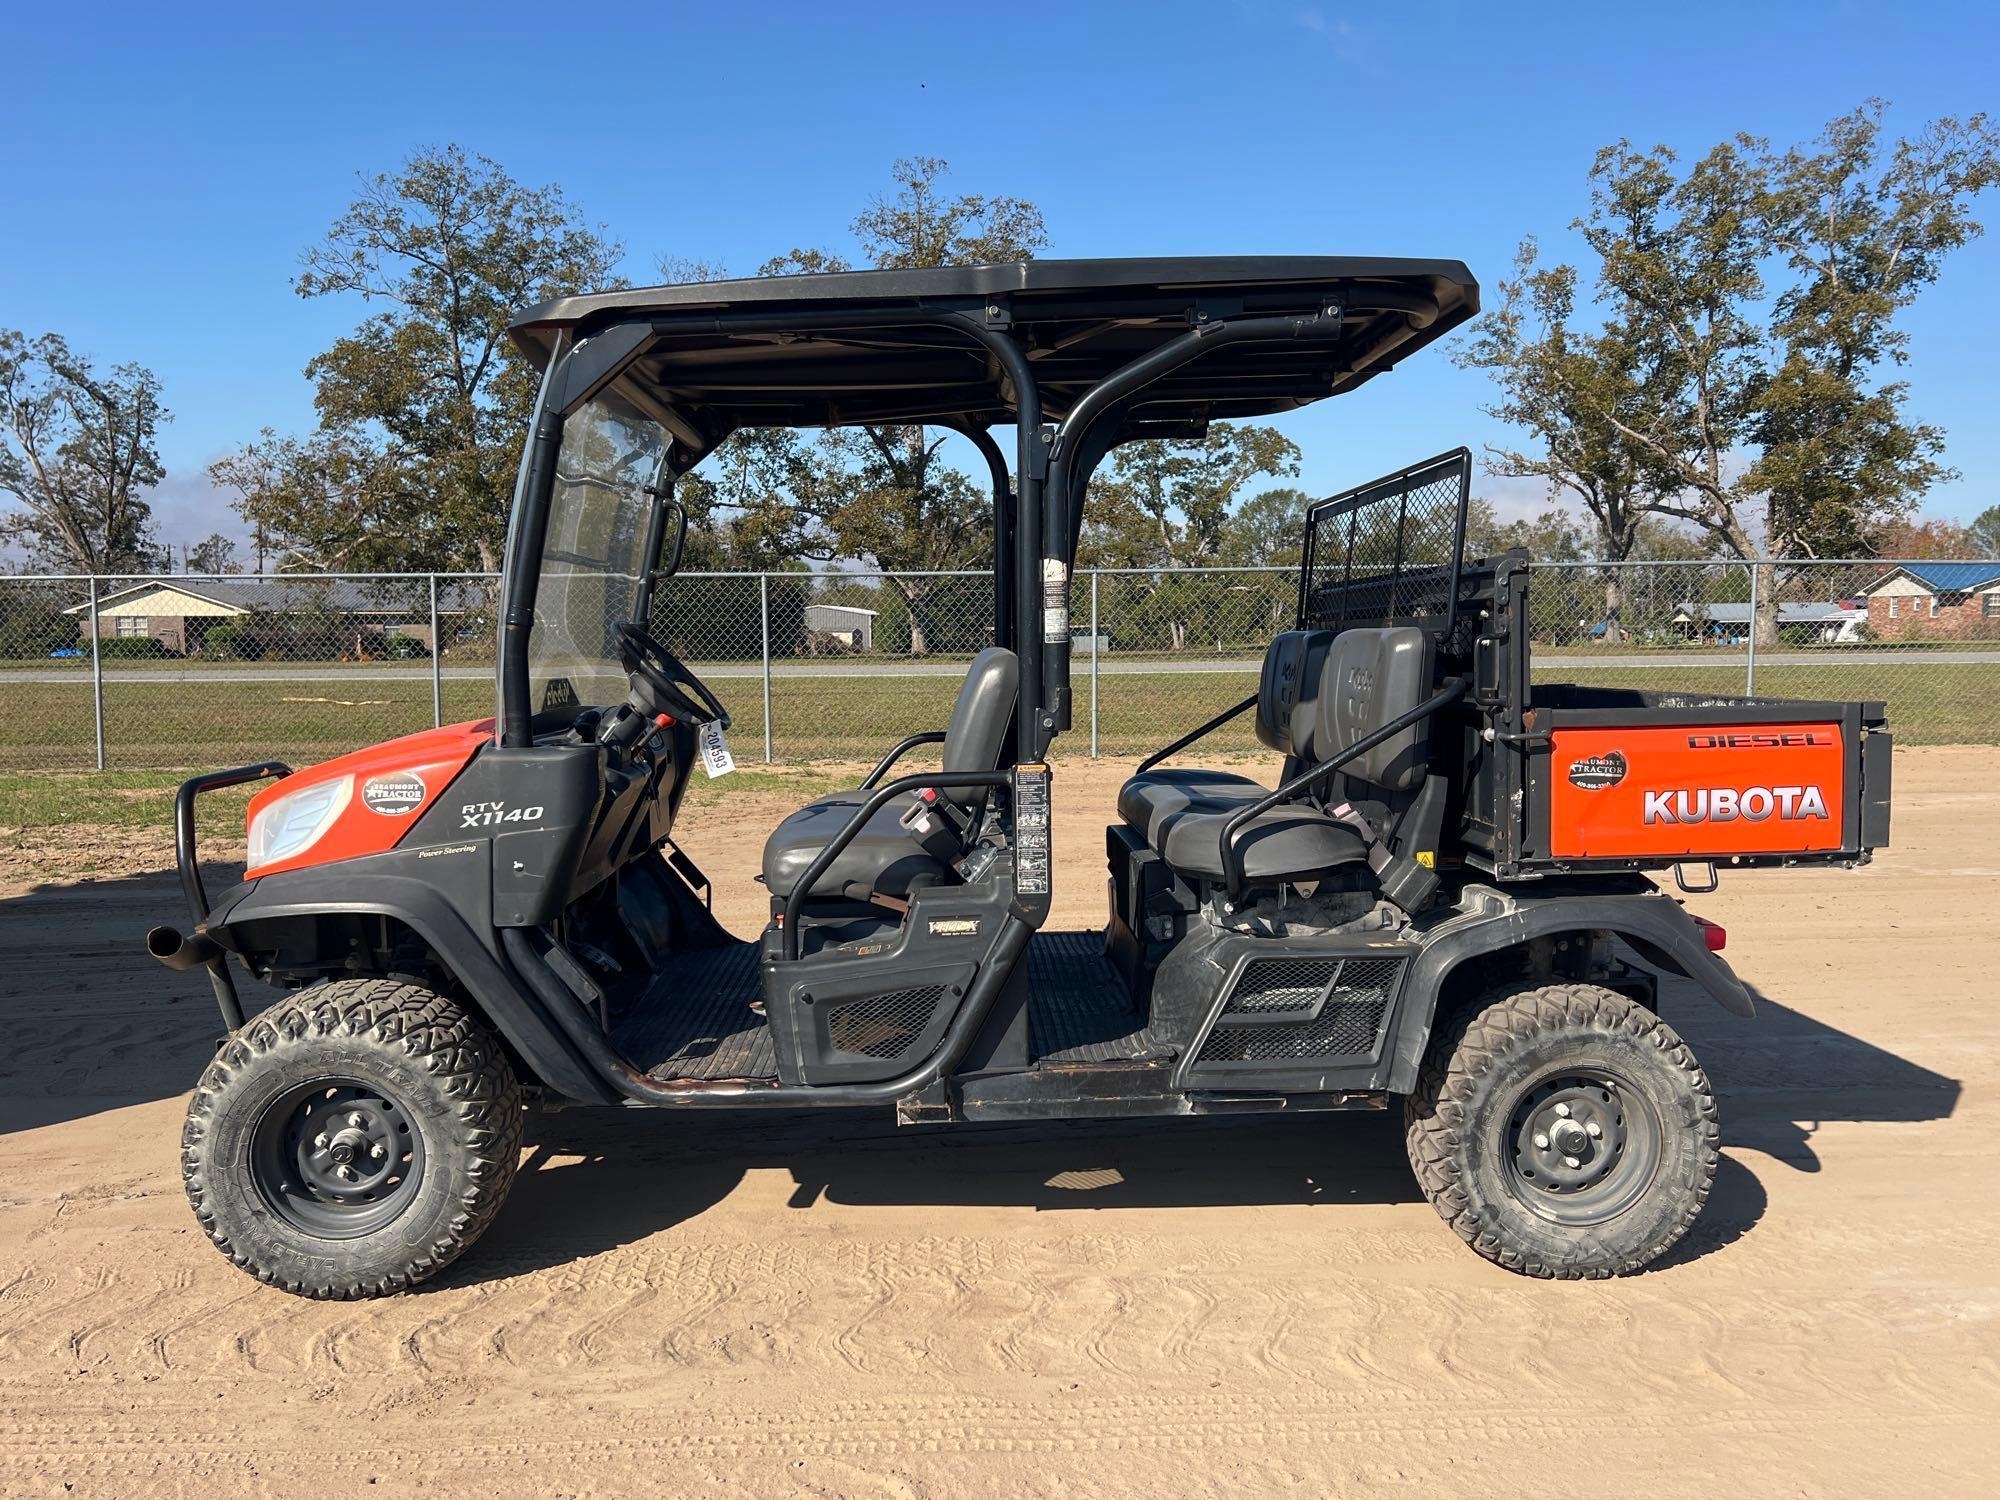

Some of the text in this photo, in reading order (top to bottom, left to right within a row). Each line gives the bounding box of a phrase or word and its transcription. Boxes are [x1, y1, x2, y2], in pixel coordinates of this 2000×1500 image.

[1688, 734, 1832, 748] DIESEL
[707, 731, 727, 769] 204593
[1577, 765, 1623, 774] TRACTOR
[376, 790, 422, 798] TRACTOR
[461, 801, 505, 814] RTV
[1644, 786, 1829, 824] KUBOTA
[459, 806, 544, 828] X1140
[418, 844, 477, 859] Power Steering
